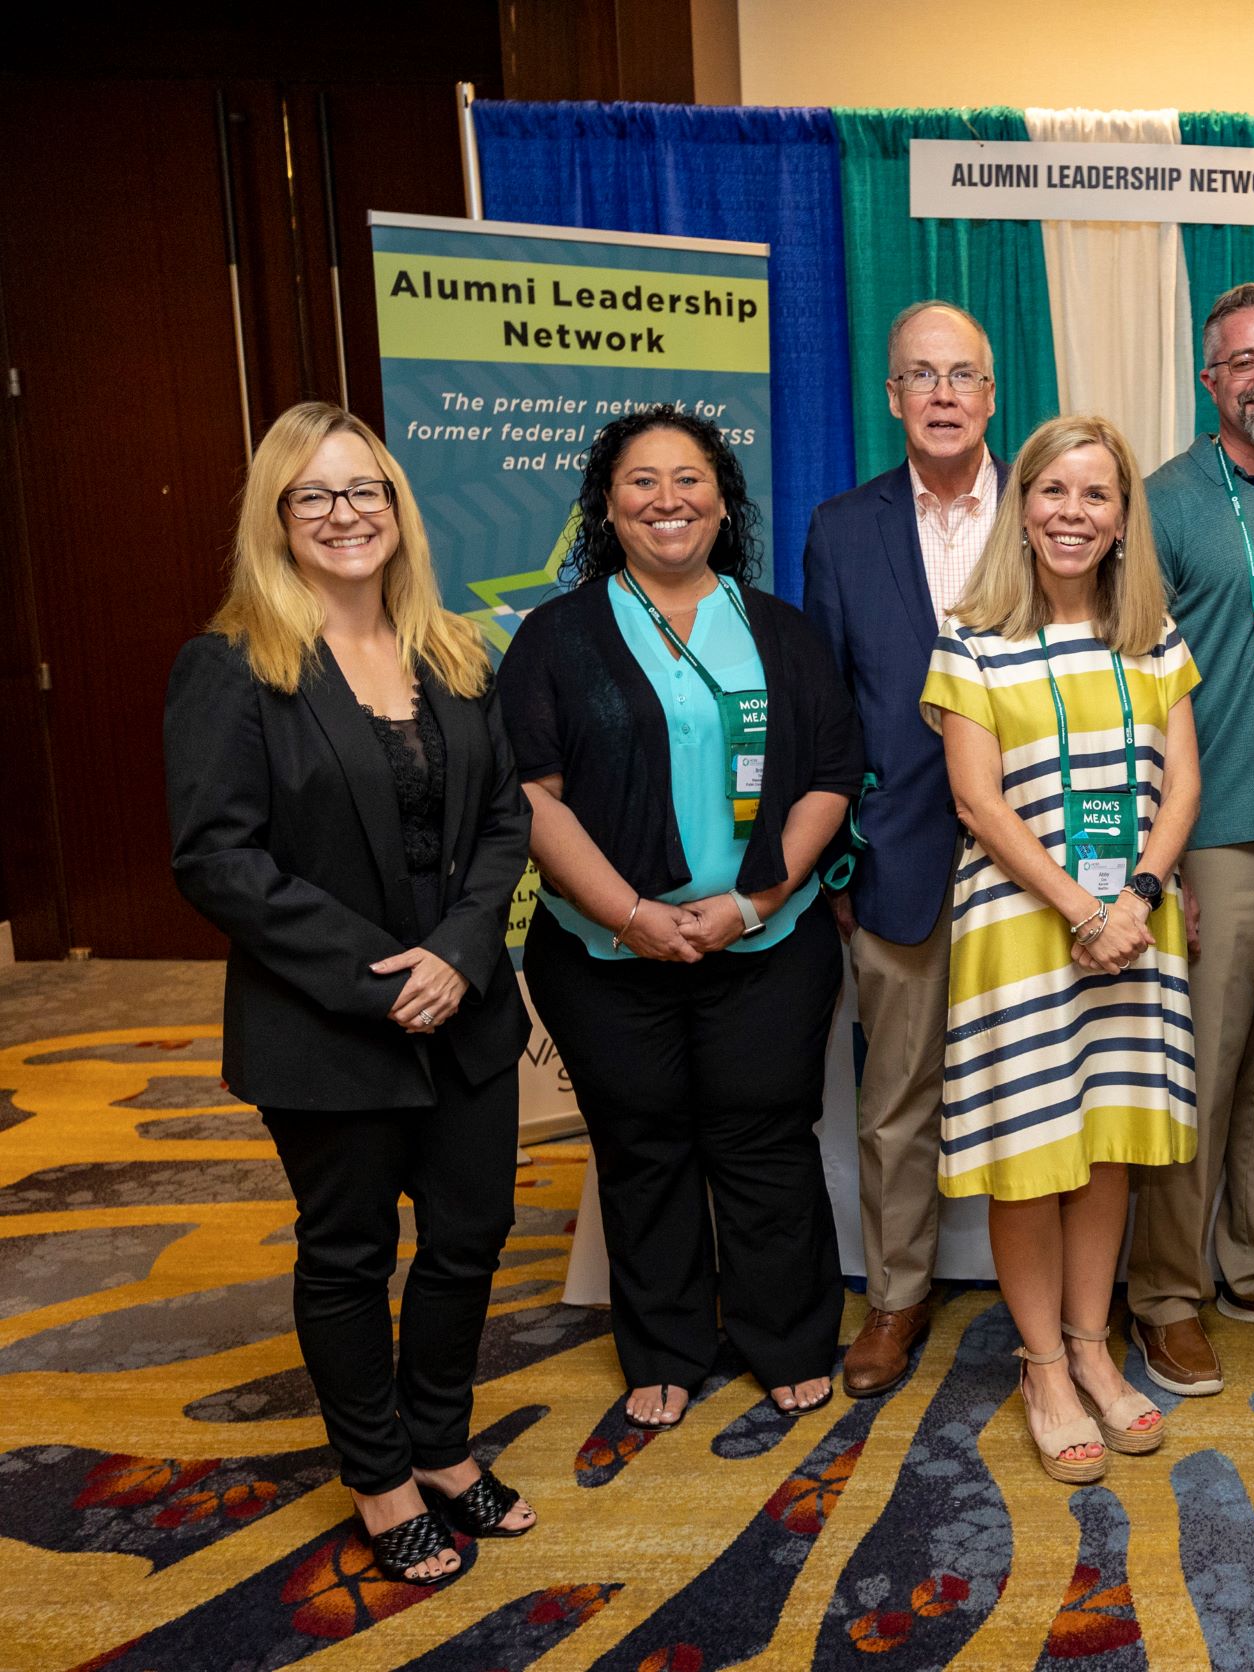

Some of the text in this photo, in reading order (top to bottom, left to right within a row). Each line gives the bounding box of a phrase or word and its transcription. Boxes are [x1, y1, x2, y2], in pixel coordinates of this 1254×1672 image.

[951, 162, 1038, 189] ALUMNI
[1047, 163, 1182, 192] LEADERSHIP
[390, 270, 758, 322] Alumni Leadership
[503, 321, 665, 353] Network
[442, 393, 485, 411] The
[493, 395, 587, 415] premier
[695, 400, 727, 418] for
[407, 421, 492, 440] former
[501, 423, 586, 442] federal
[503, 453, 589, 471] and HC
[740, 698, 768, 710] MOM
[743, 712, 767, 723] MEA
[1082, 799, 1120, 811] MOM'S
